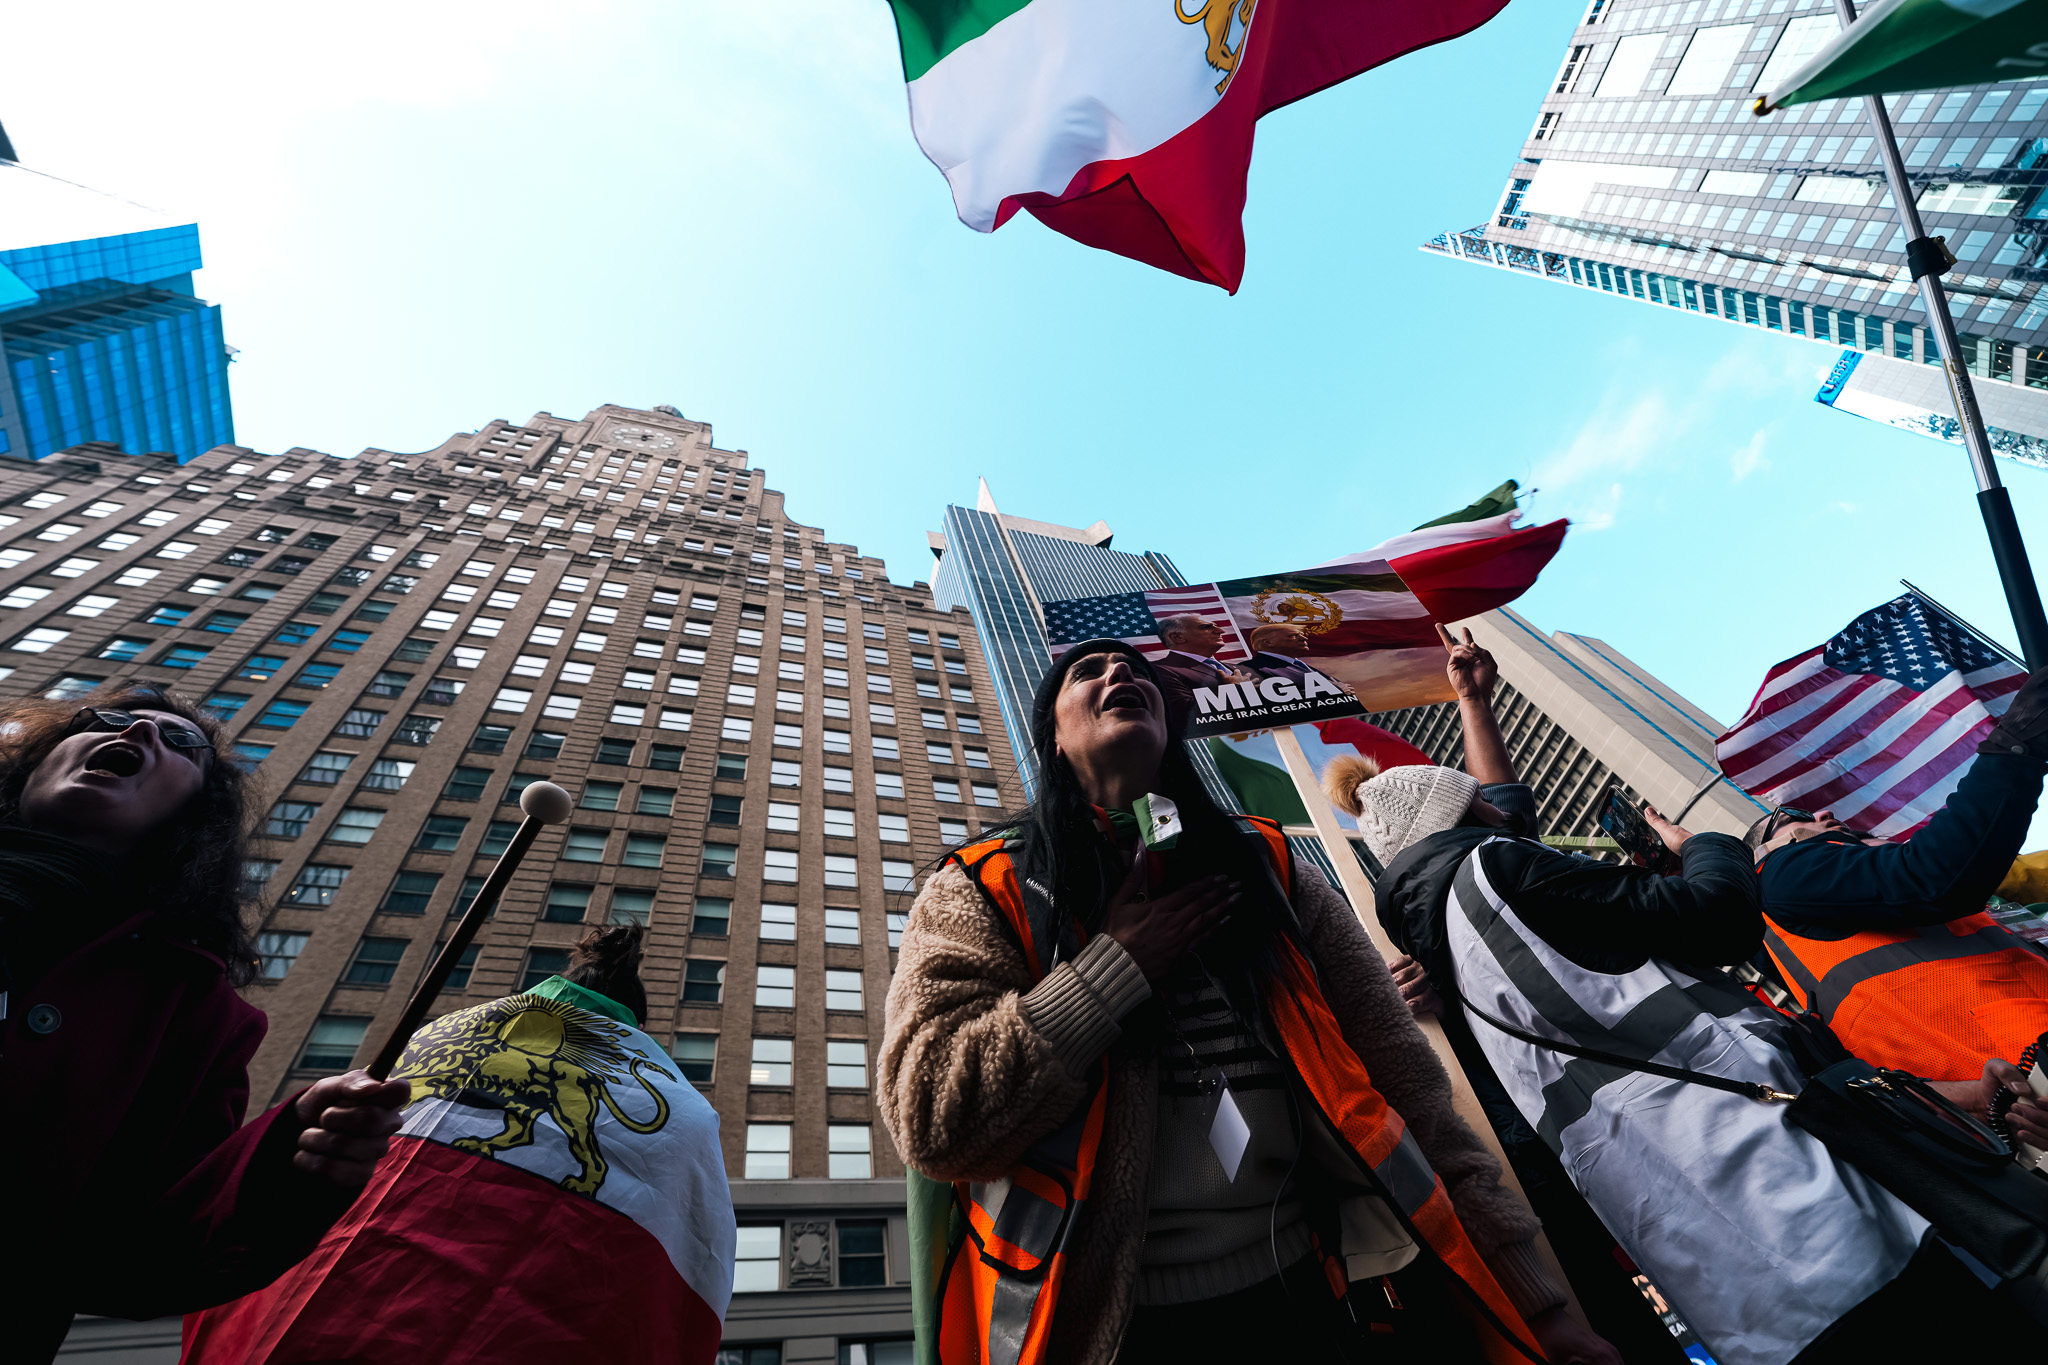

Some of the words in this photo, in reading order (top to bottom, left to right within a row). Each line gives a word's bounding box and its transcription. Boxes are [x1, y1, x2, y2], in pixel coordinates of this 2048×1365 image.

[1192, 671, 1344, 714] MIGA
[1196, 713, 1234, 725] MAKE
[1236, 708, 1269, 719] IRAN
[1271, 701, 1316, 714] GREAT
[1317, 694, 1359, 707] AGAIN
